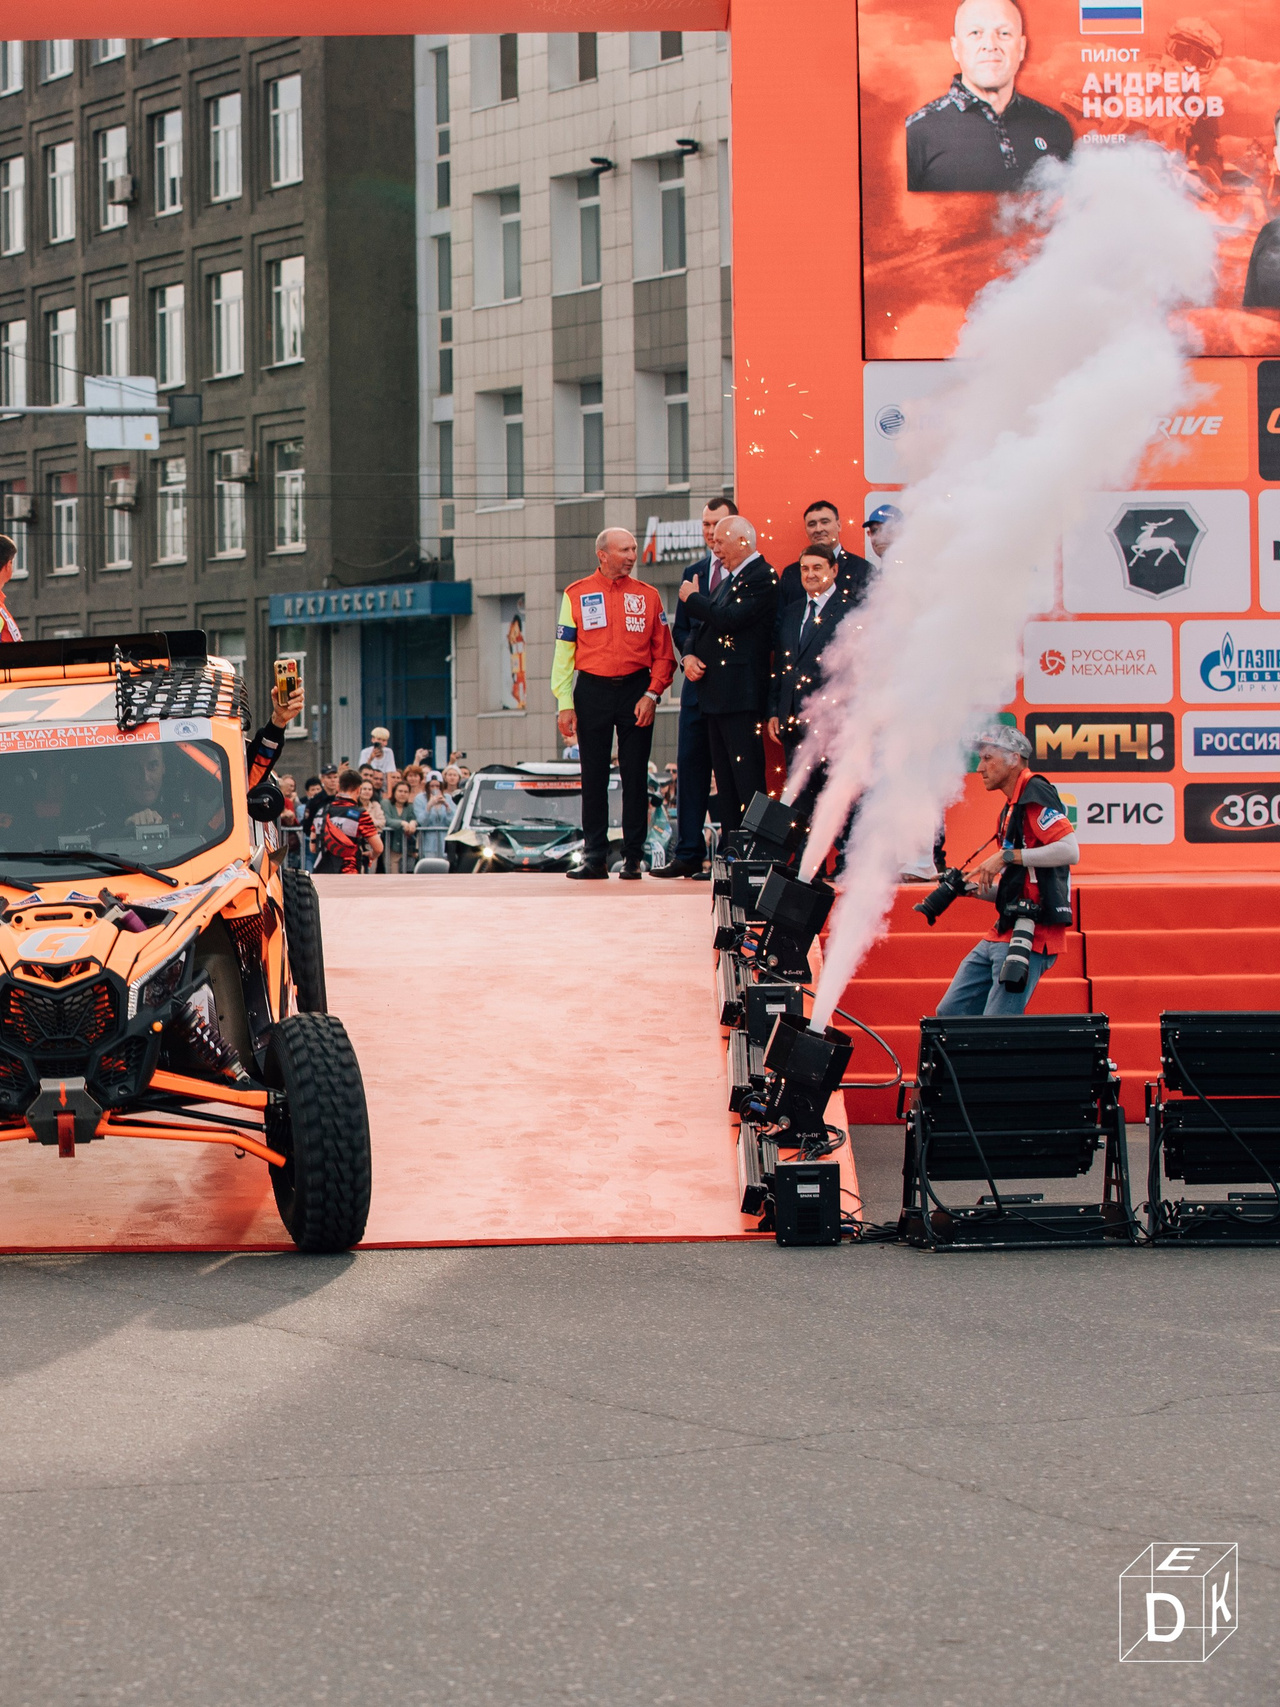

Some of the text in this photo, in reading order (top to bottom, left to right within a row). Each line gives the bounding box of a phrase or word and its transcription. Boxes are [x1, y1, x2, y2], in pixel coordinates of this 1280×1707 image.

[1081, 48, 1140, 63] ПИЛОТ
[1082, 66, 1200, 96] АНДРЕЙ
[1082, 96, 1225, 119] НОВИКОВ
[1082, 134, 1127, 144] DRIVER
[284, 588, 414, 617] ИРКУТСКСТАТ
[625, 616, 646, 625] SILK
[625, 624, 646, 633] WAY
[1071, 649, 1146, 661] РУССКАЯ
[1237, 649, 1280, 669] ГАЗП
[1071, 663, 1157, 676] МЕХАНИКА
[1239, 671, 1280, 682] ДОБ
[17, 738, 69, 750] EDITION
[85, 732, 156, 745] MONGOLIA
[23, 729, 55, 740] WAY
[57, 726, 99, 738] RALLY
[1035, 723, 1164, 761] МАТЧ!
[1201, 732, 1280, 751] РОССИЯ
[1087, 802, 1164, 825] 2ГИС
